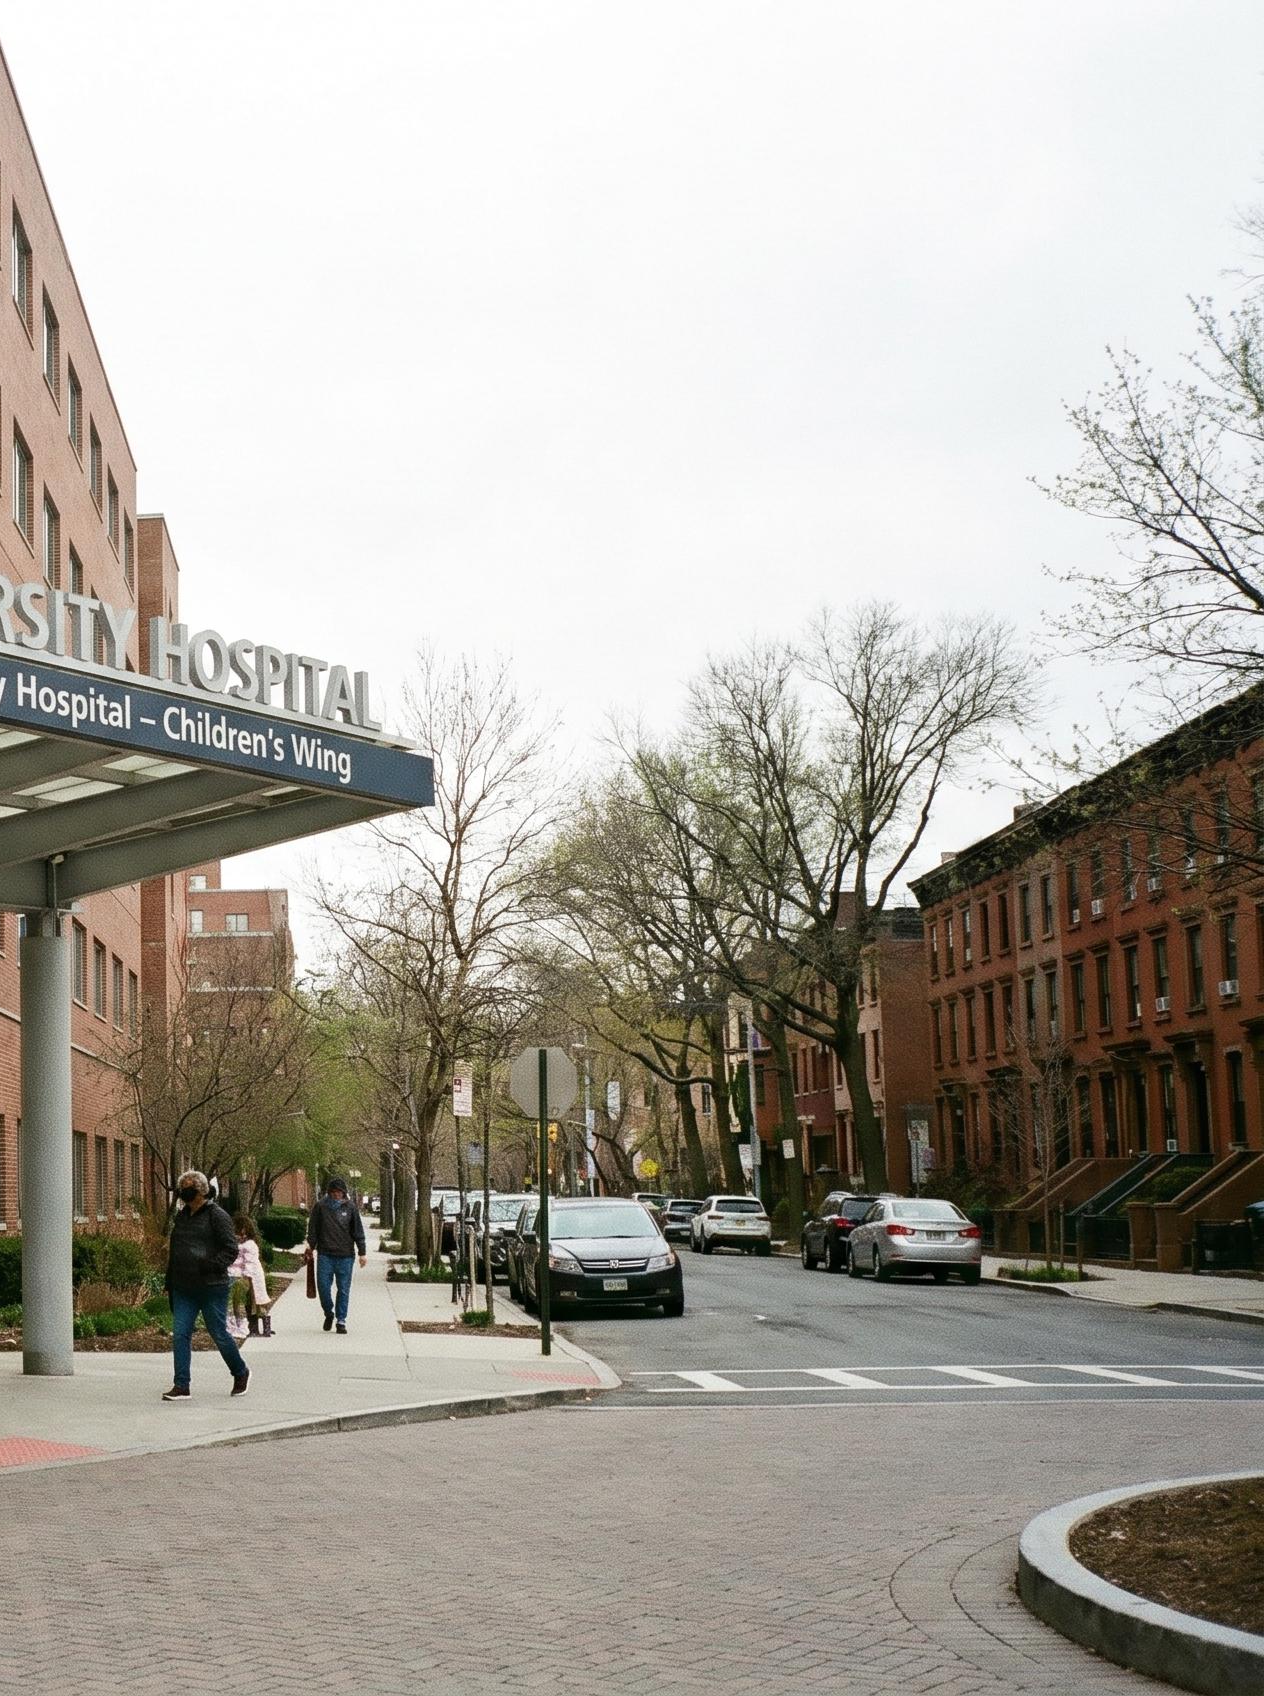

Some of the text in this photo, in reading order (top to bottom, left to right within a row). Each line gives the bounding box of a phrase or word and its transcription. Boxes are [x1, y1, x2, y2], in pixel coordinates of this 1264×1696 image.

[17, 672, 132, 730] Hospital
[163, 706, 285, 762] Children's
[291, 733, 352, 784] Wing
[149, 615, 382, 731] HOSPITAL
